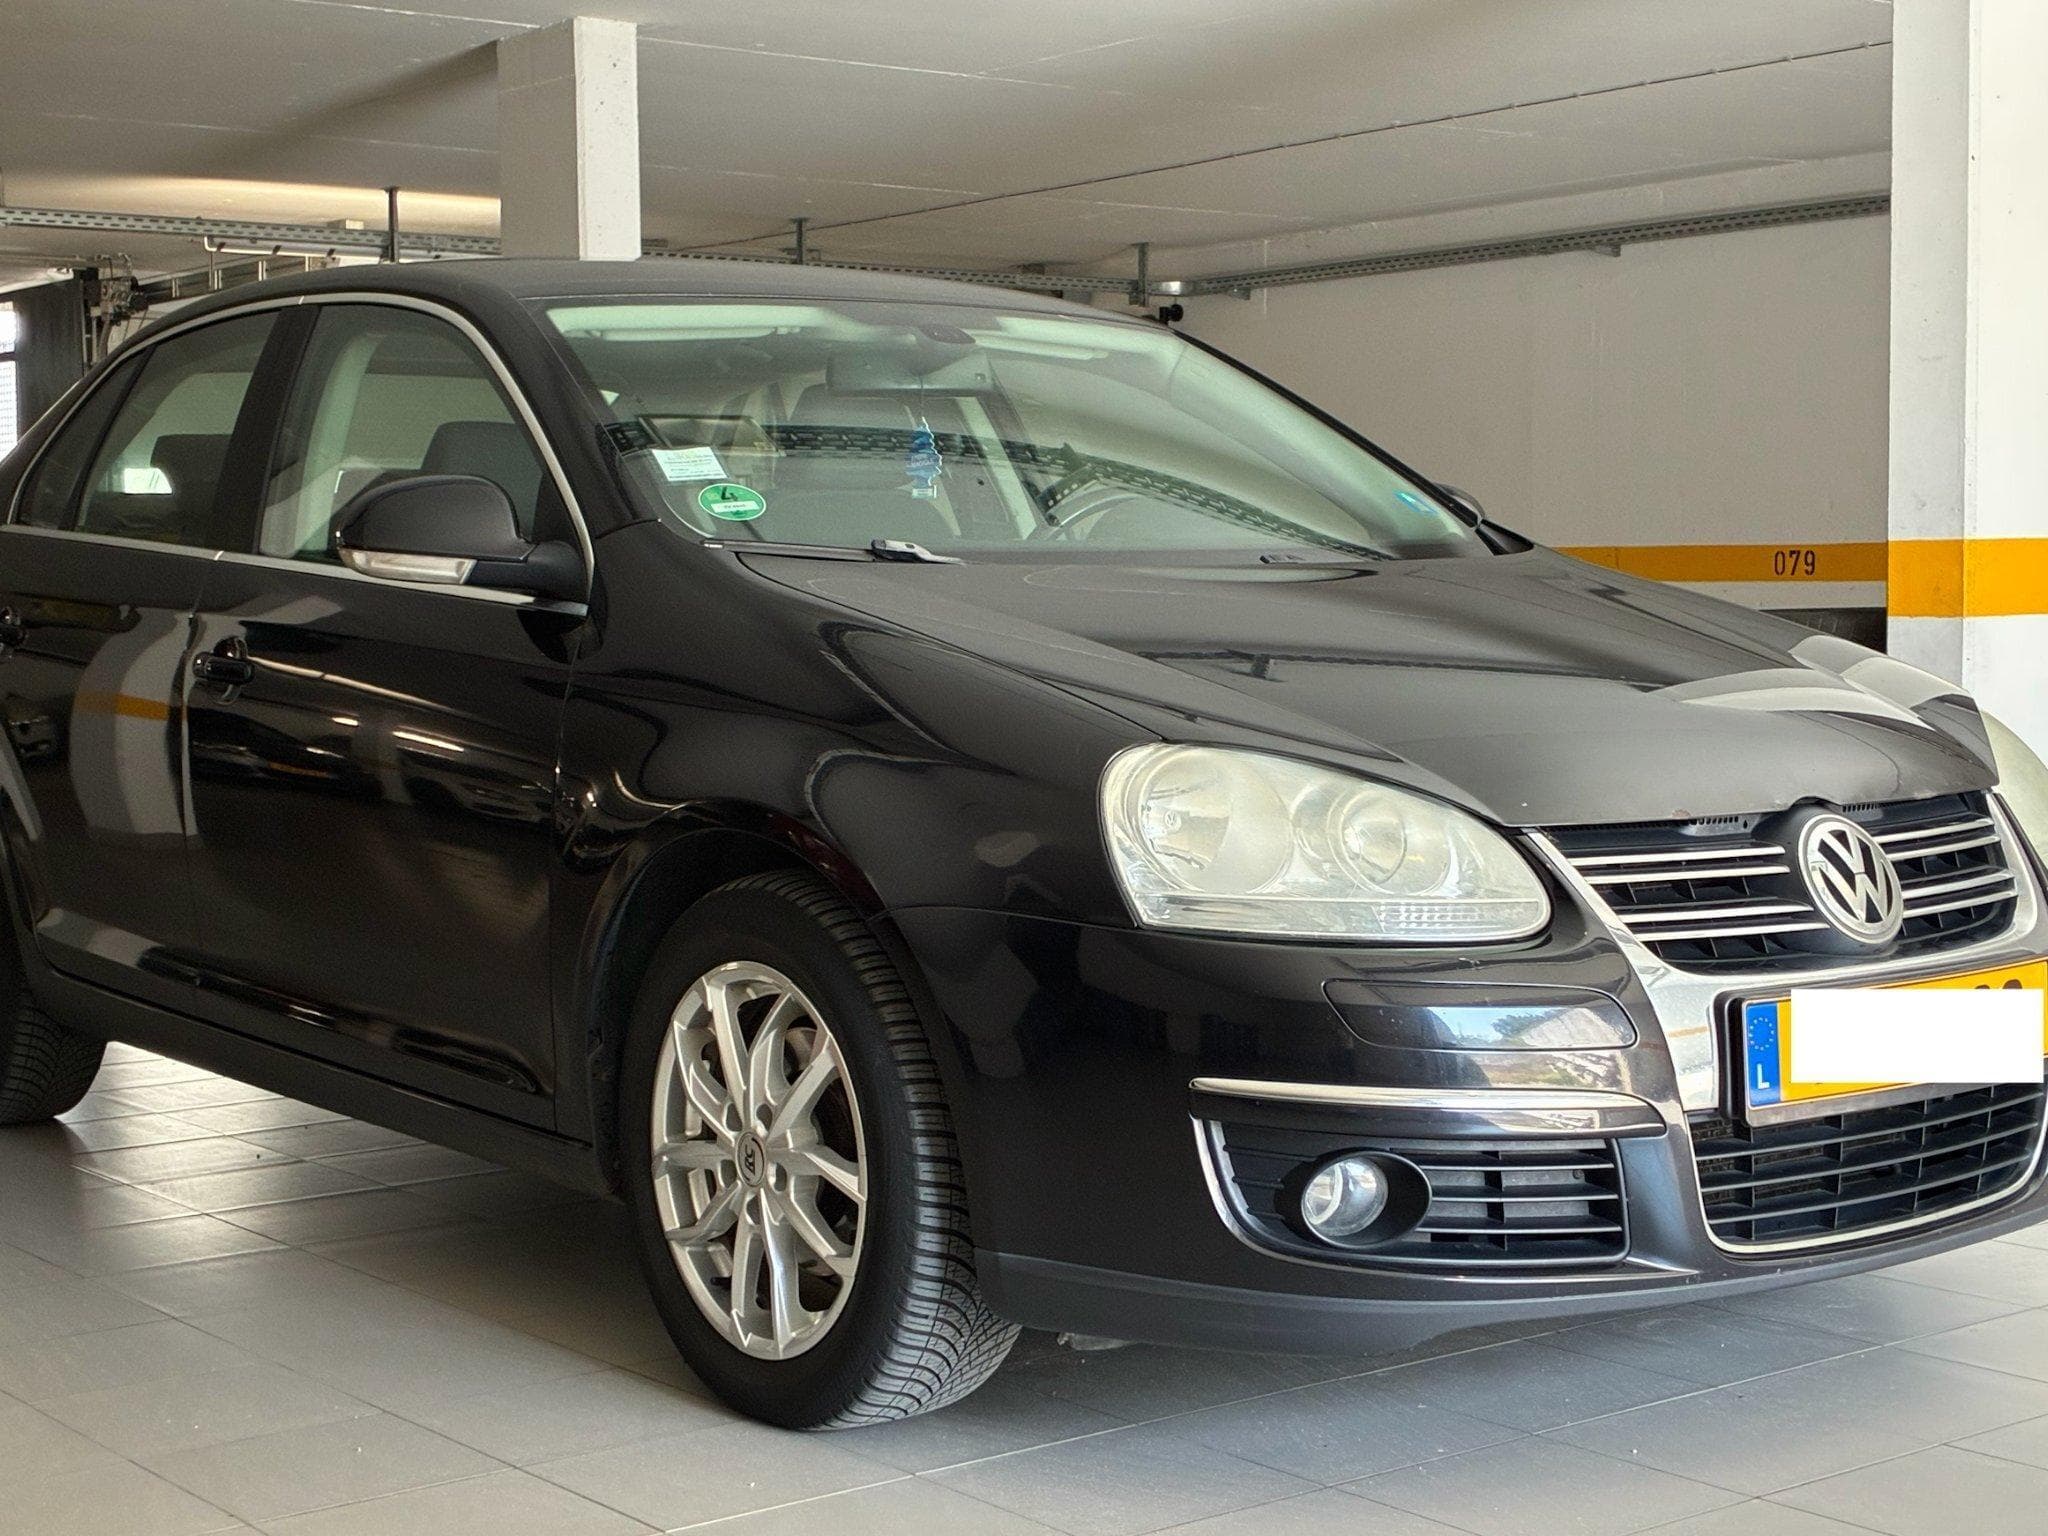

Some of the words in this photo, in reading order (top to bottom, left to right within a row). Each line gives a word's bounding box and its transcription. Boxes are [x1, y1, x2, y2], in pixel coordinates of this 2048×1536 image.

[1774, 550, 1815, 576] 079
[1807, 821, 1898, 933] VW
[1757, 1063, 1770, 1090] L
